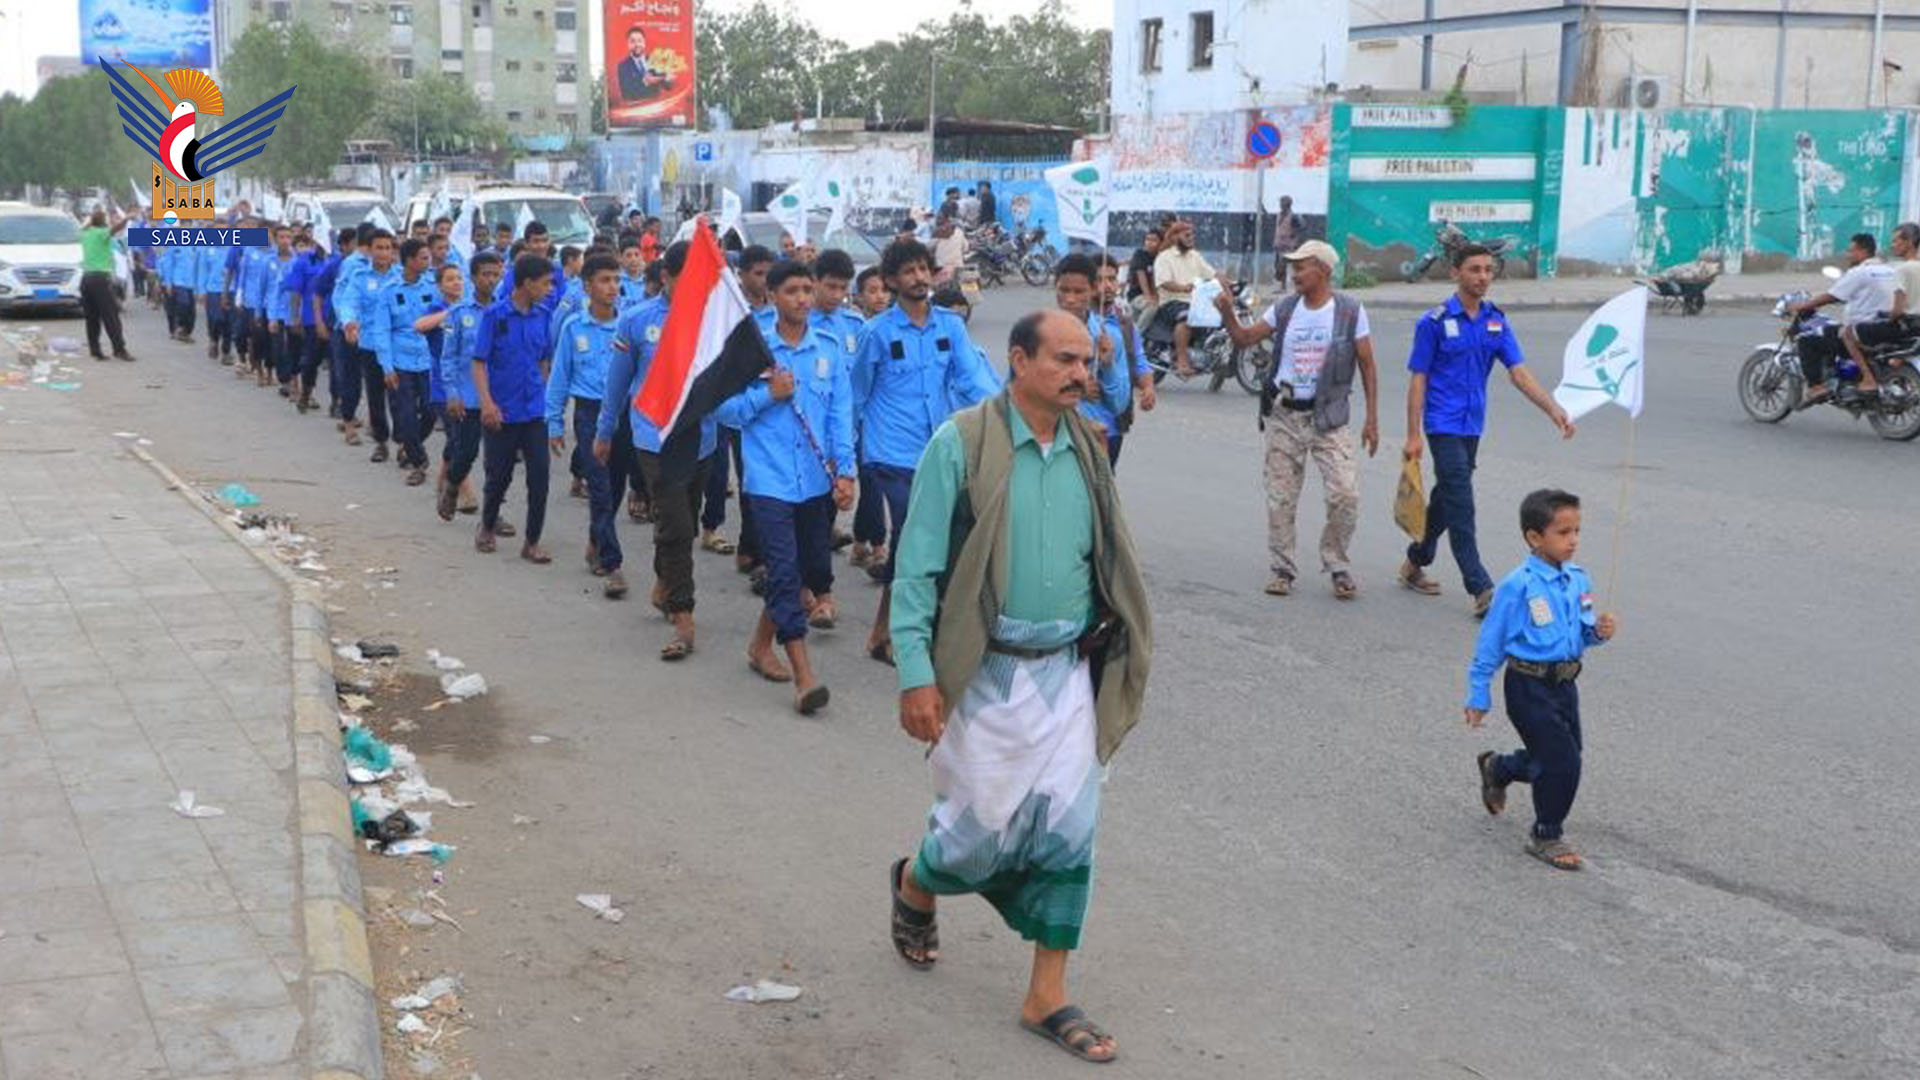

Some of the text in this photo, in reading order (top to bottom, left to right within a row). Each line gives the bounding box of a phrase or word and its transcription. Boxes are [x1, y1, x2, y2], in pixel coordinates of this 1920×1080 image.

[1362, 109, 1436, 121] FREE PALESTIN
[1384, 158, 1474, 173] FREE PALESTIN
